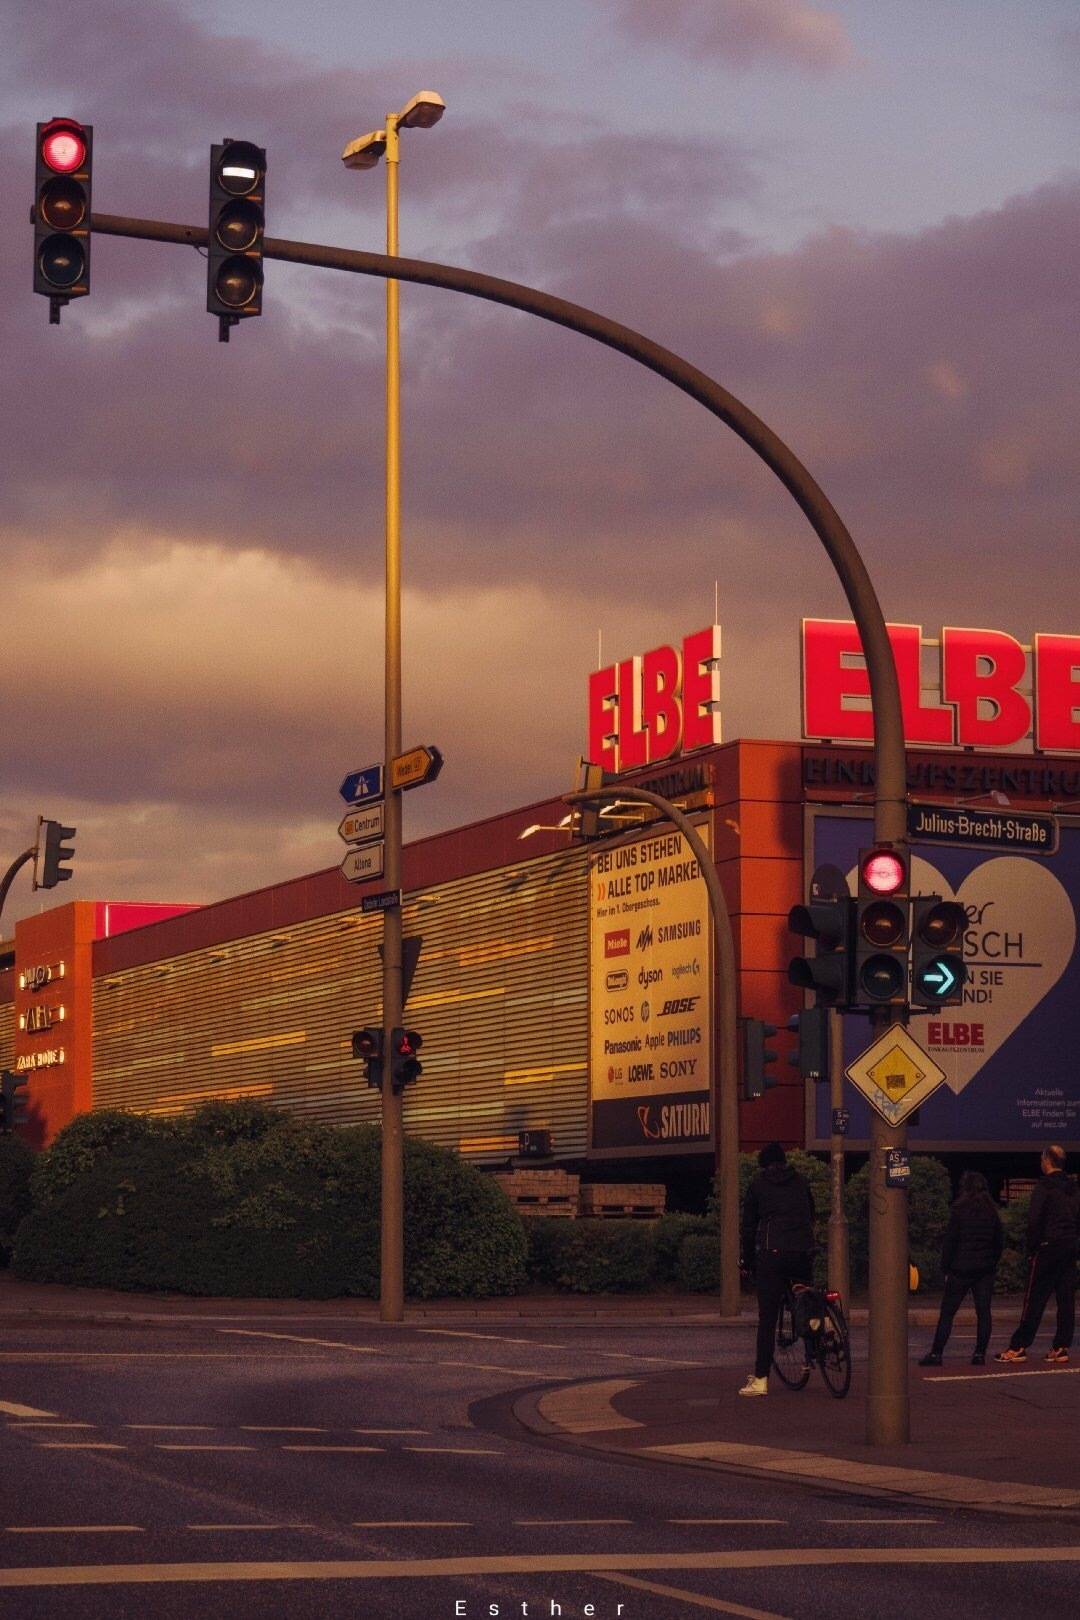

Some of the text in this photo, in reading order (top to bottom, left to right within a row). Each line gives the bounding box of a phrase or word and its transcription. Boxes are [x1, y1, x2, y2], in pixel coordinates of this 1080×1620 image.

[802, 617, 1080, 750] ELBE
[589, 624, 721, 774] ELBE
[355, 815, 380, 832] Centrum
[915, 812, 1047, 842] Julius-Brecht-Straße
[597, 835, 682, 874] BEI UNS STEHEN
[608, 876, 632, 899] ALLE
[634, 870, 655, 893] TOP
[658, 919, 701, 944] SAMSUNG
[963, 930, 1023, 959] SCH
[638, 965, 663, 990] dyson
[980, 970, 1004, 987] SIE
[963, 989, 993, 1004] ND!
[604, 1005, 635, 1026] SONOS
[657, 996, 701, 1017] BOSE
[604, 1027, 701, 1055] Panasonic Apple PHILIPS
[927, 1021, 985, 1046] ELBE
[660, 1058, 698, 1079] SONY
[661, 1102, 710, 1139] SATURN
